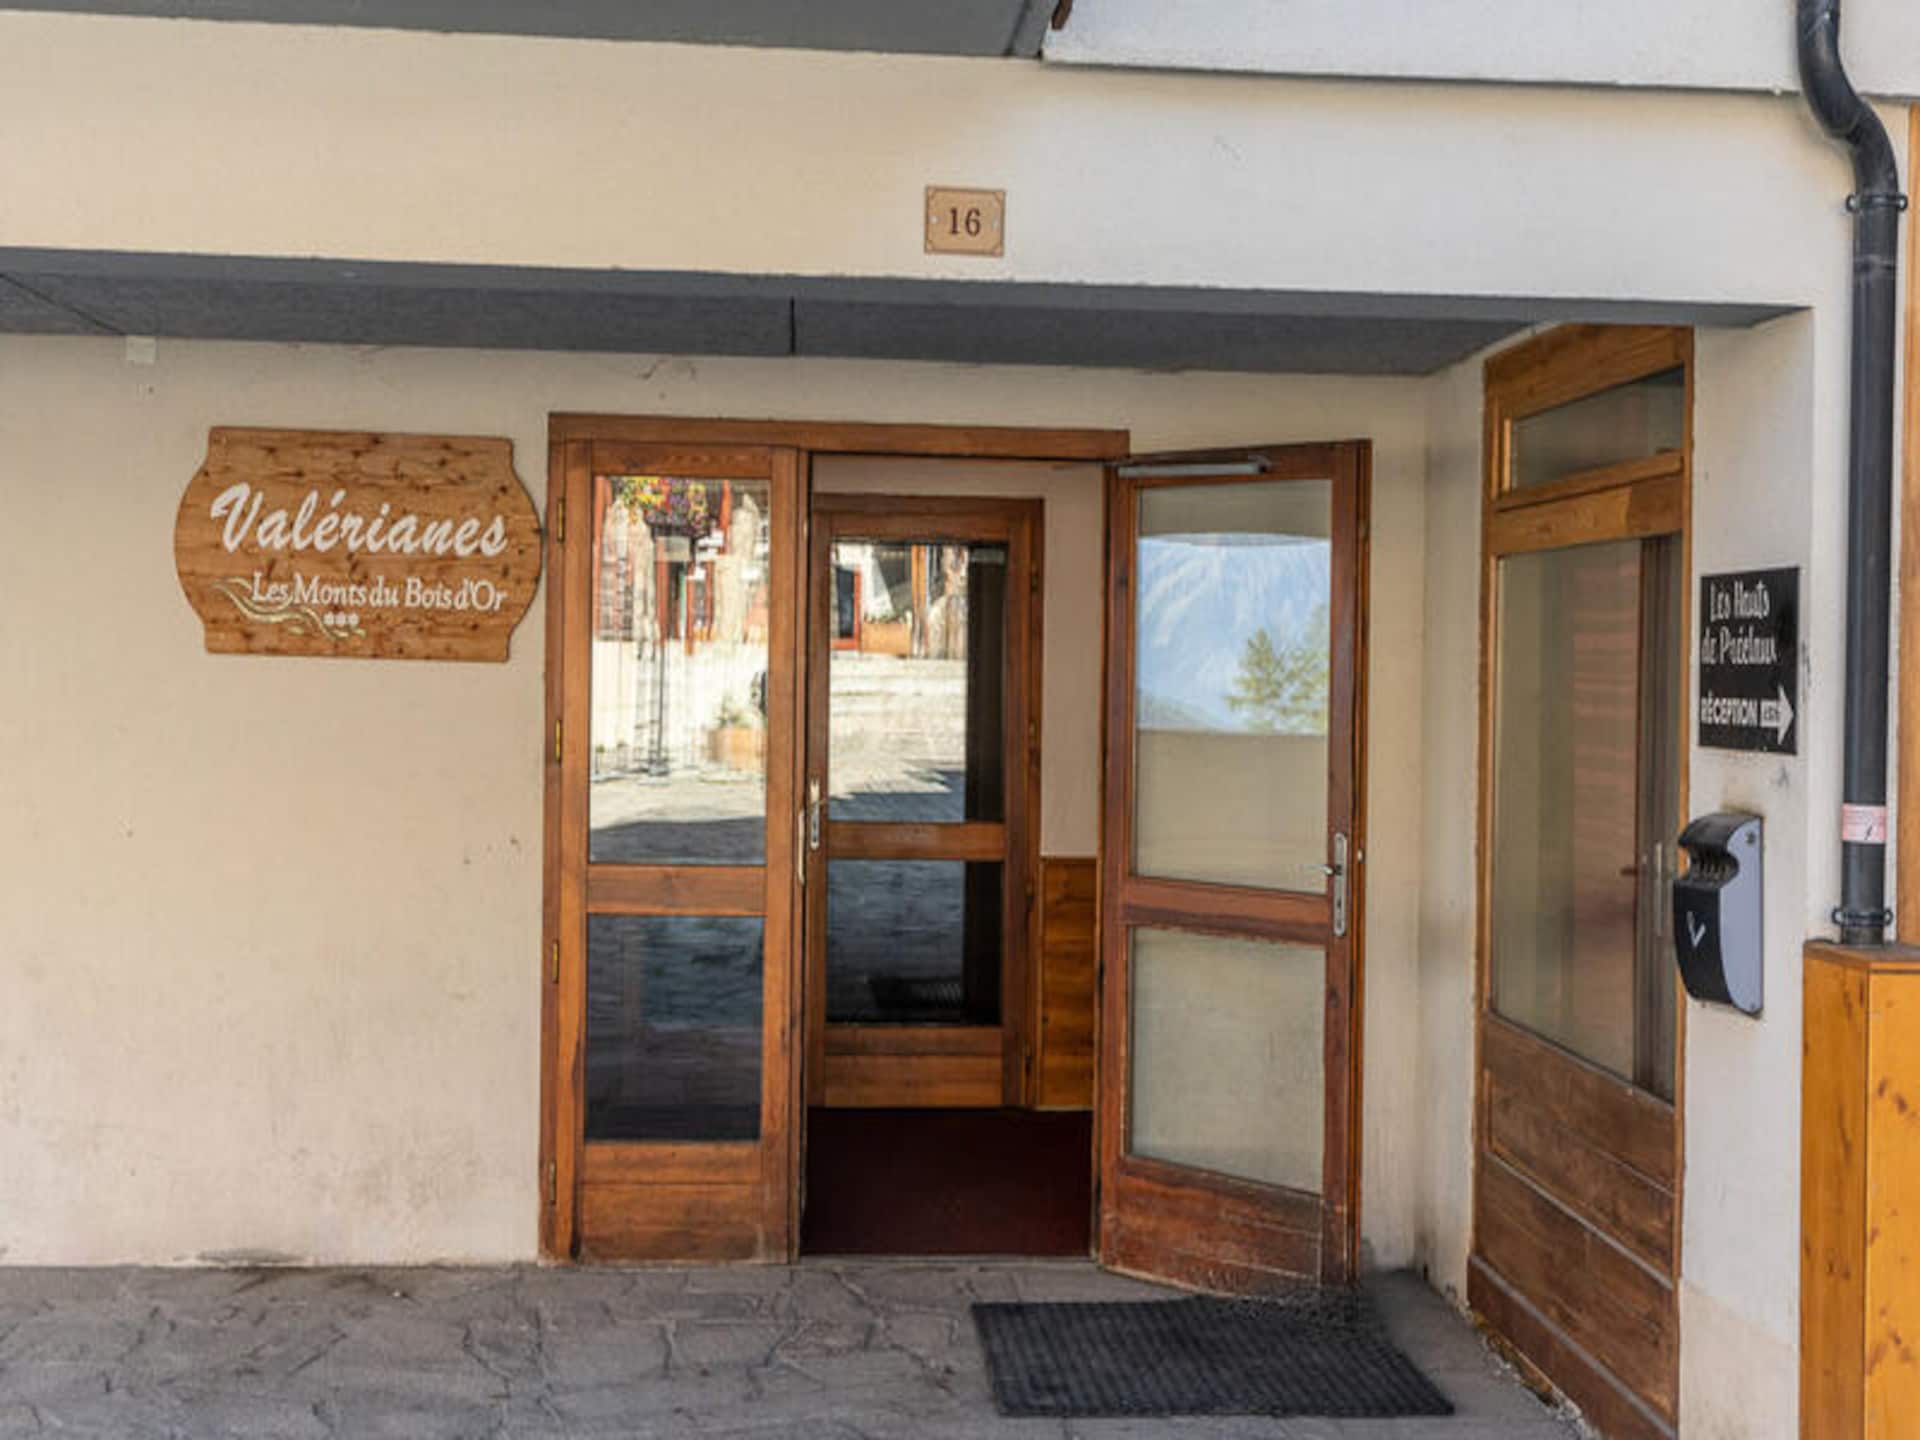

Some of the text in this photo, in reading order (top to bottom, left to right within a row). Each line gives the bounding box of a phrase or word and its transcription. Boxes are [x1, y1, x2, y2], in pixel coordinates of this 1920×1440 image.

[950, 207, 981, 237] 16
[210, 482, 508, 556] Valérianes
[251, 571, 508, 611] Les Monts du Bois d'Or
[1710, 579, 1771, 622] Les Hauts
[1701, 626, 1718, 665] de
